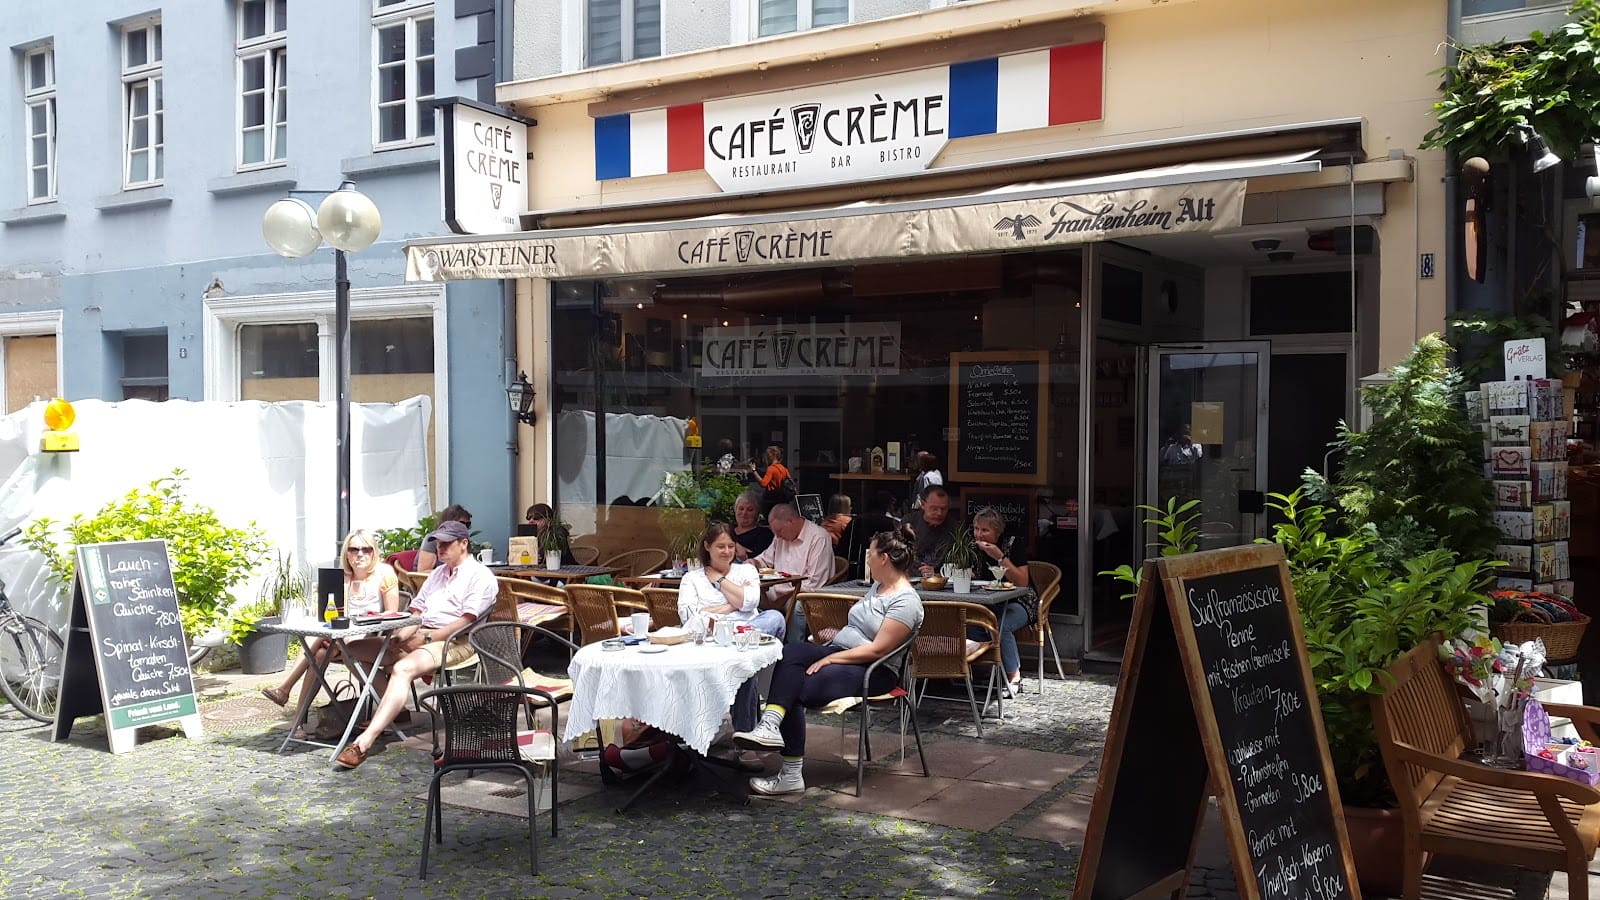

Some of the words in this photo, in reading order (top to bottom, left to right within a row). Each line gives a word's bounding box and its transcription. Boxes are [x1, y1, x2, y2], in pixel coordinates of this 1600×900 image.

[473, 122, 513, 154] CAFÉ
[708, 108, 786, 161] CAFÉ
[823, 93, 944, 146] CRÈME
[466, 150, 521, 184] CRÈME
[732, 161, 798, 179] RESTAURANT
[830, 154, 851, 169] BAR
[879, 145, 921, 163] BISTRO
[1043, 199, 1172, 241] Frankenheim
[1175, 197, 1216, 224] Alt
[439, 244, 557, 268] WARSTEINER
[678, 231, 730, 264] CAFÉ
[755, 227, 833, 260] CRÈME
[1423, 255, 1431, 275] 8
[706, 331, 768, 369] CAFÉ
[797, 328, 896, 369] CRÈME
[1517, 354, 1544, 363] VERLAG
[113, 602, 157, 617] Quiche
[1220, 619, 1257, 649] Penne
[128, 652, 167, 668] tomaten
[132, 667, 164, 682] Quiche
[1264, 727, 1281, 749] mit
[1248, 828, 1278, 859] Penne
[1278, 815, 1298, 842] mit
